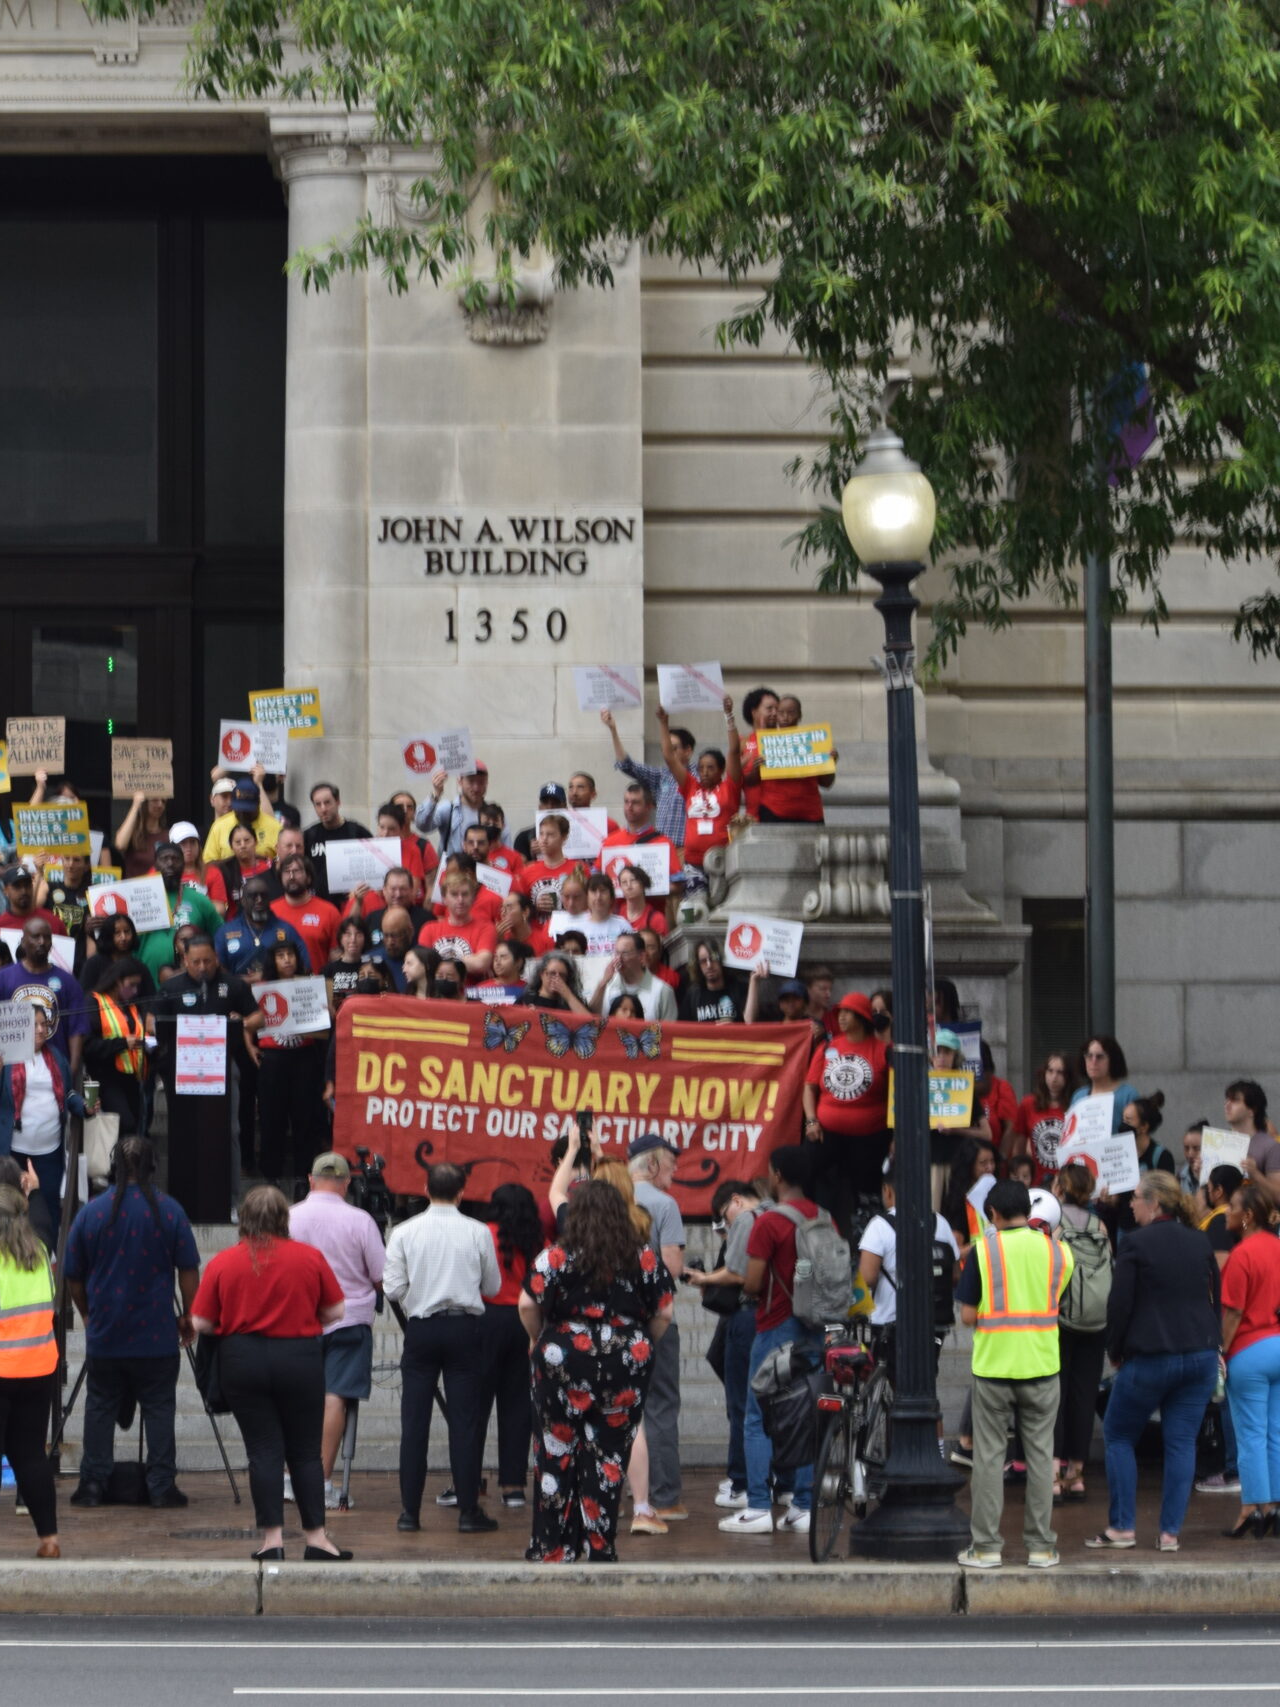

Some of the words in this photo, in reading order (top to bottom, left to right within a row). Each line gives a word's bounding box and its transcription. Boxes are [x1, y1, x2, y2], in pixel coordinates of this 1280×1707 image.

[378, 517, 463, 544] JOHN
[475, 516, 503, 543] A.
[508, 516, 636, 543] WILSON
[424, 550, 588, 577] BUILDING
[445, 608, 568, 643] 1350
[254, 693, 298, 709] INVEST
[301, 692, 314, 705] IN
[256, 706, 285, 719] KIDS
[8, 720, 40, 736] FUND
[762, 735, 808, 748] INVEST
[810, 730, 826, 742] IN
[8, 749, 61, 765] ALLIANCE
[763, 746, 795, 759] KIDS
[798, 745, 807, 755] &
[765, 755, 824, 769] FAMILIES
[18, 809, 64, 822] INVEST
[67, 808, 81, 821] IN
[19, 823, 50, 834] KIDS
[52, 823, 62, 833] &
[20, 833, 79, 846] FAMILIES
[356, 1050, 407, 1095] DC
[419, 1057, 664, 1114] SANCTUARY
[670, 1075, 780, 1121] NOW!
[951, 1078, 967, 1090] IN
[933, 1092, 944, 1103] &
[929, 1103, 960, 1116] LIES
[366, 1096, 479, 1133] PROTECT
[486, 1109, 536, 1139] OUR
[542, 1112, 697, 1149] SACTUARY
[702, 1122, 764, 1152] CITY
